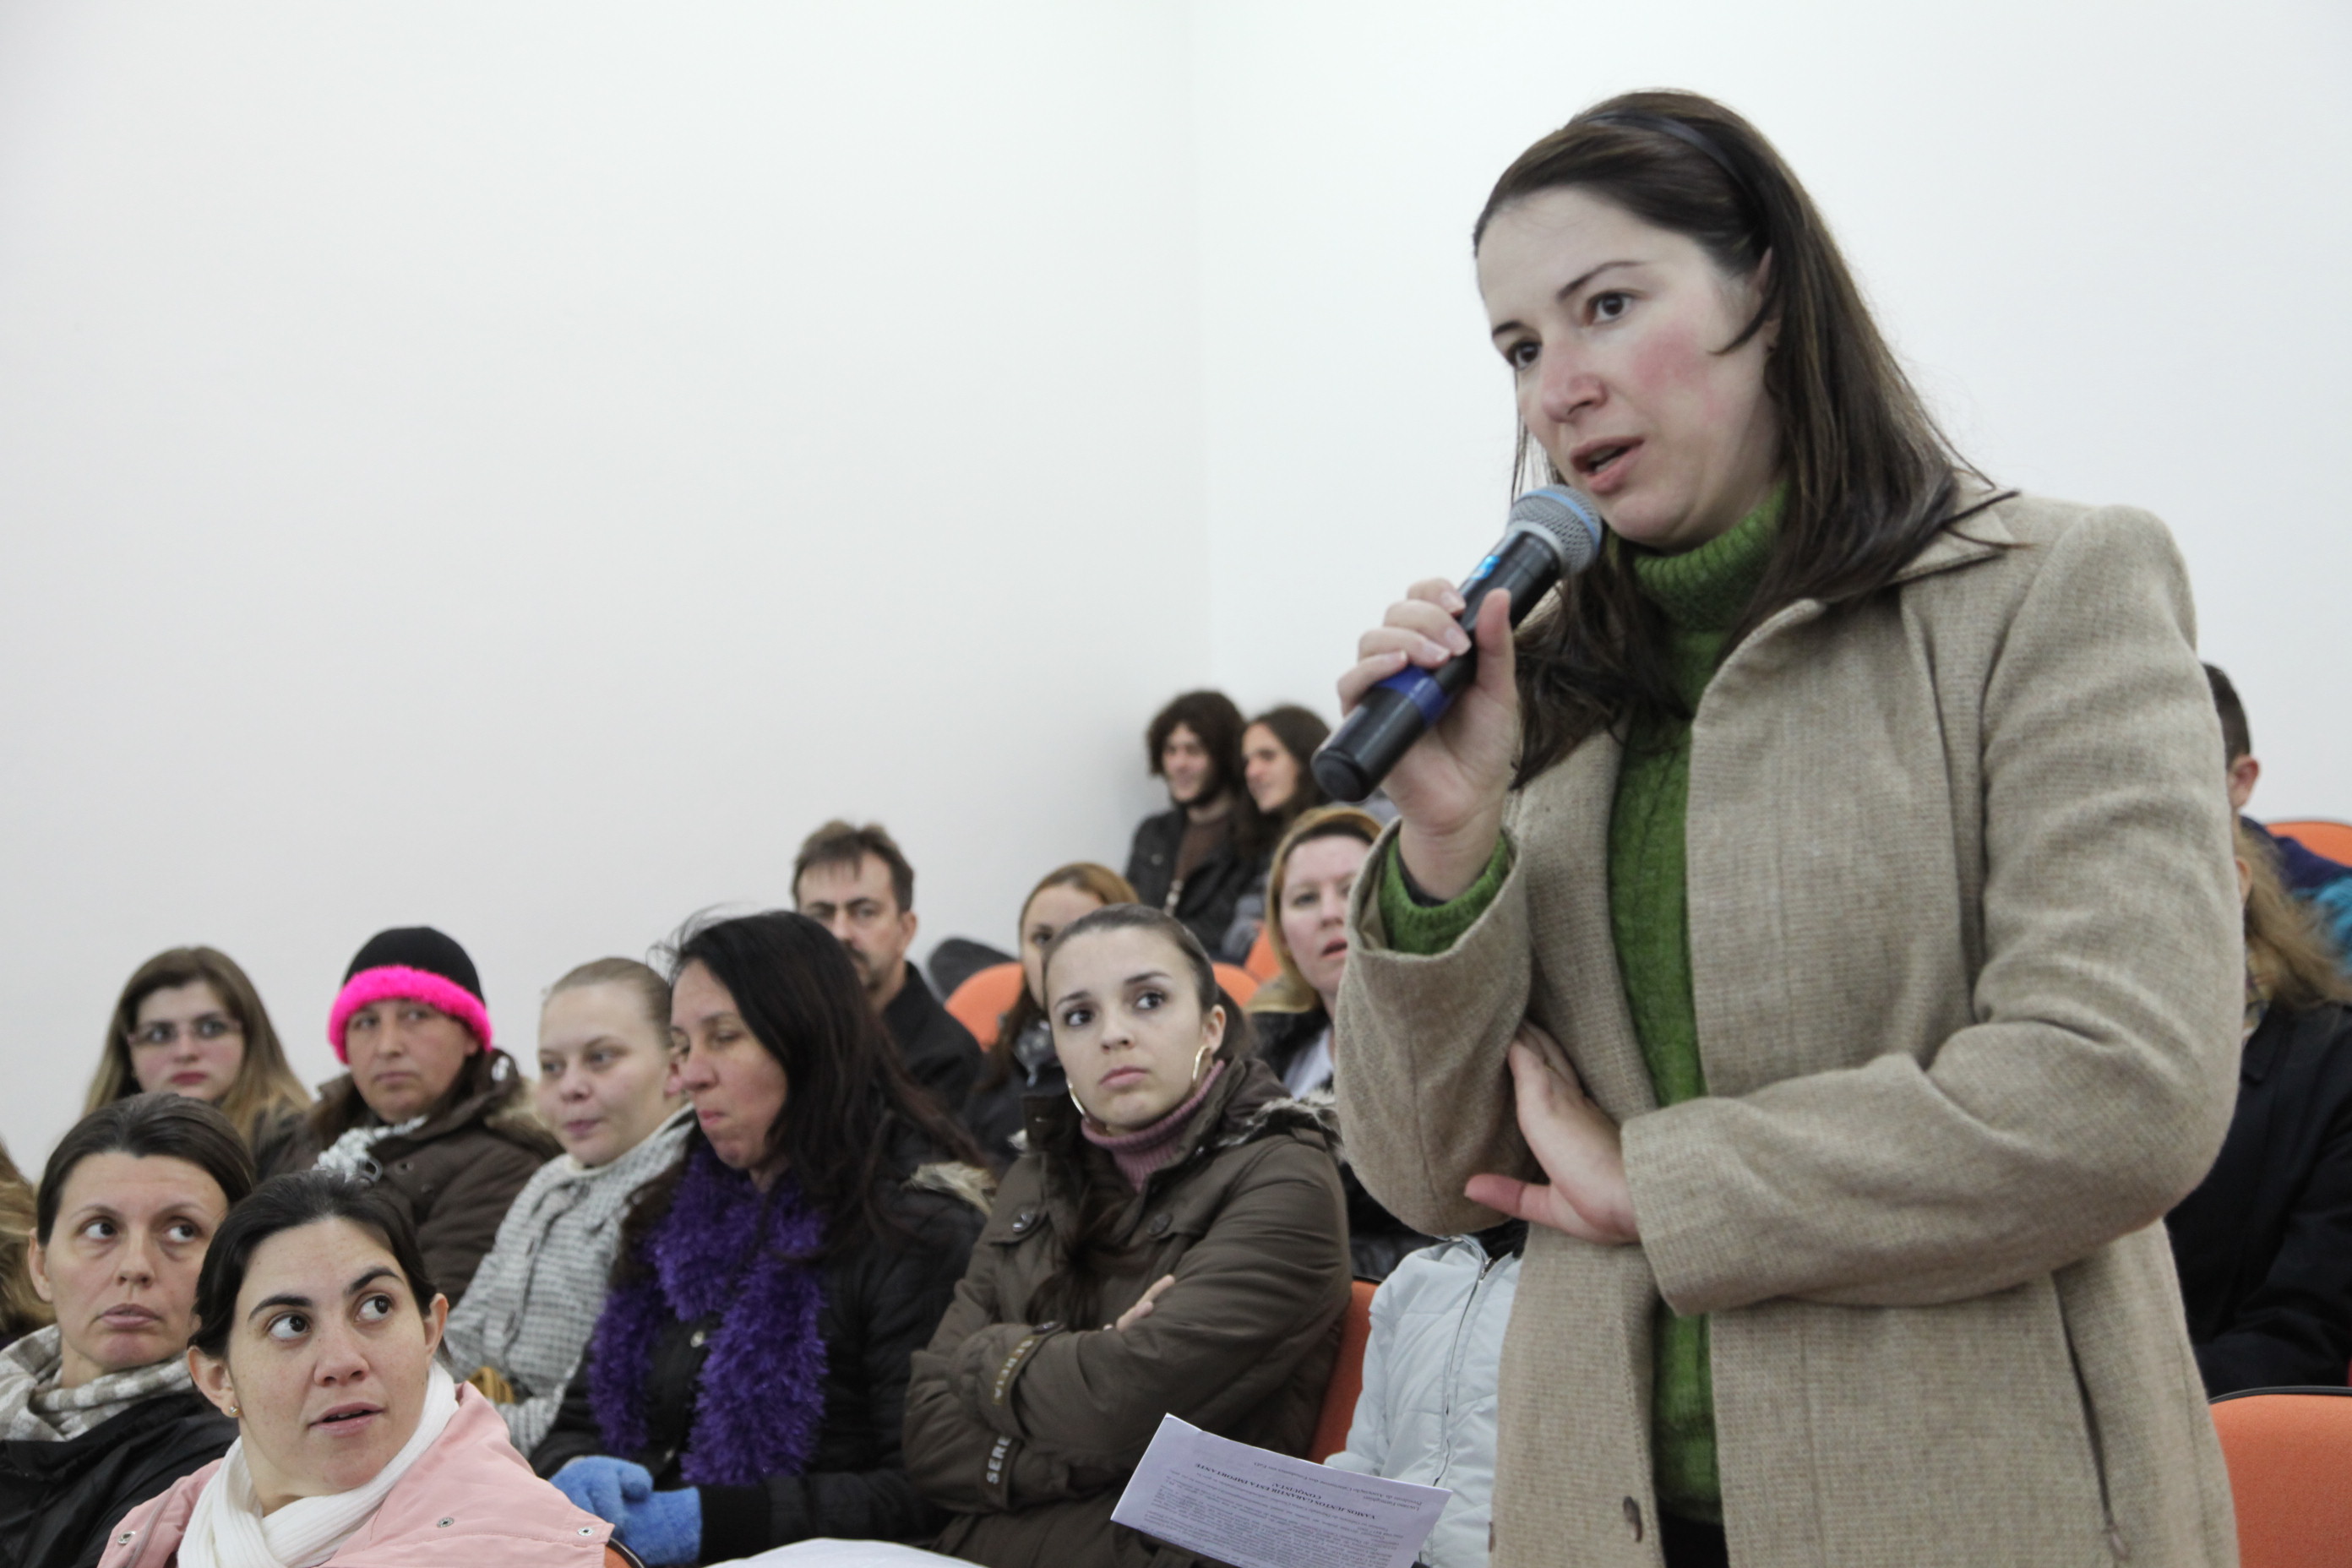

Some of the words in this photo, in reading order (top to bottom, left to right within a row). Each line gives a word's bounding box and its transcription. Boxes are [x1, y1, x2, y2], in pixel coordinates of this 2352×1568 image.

[1195, 1462, 1248, 1484] IMPORTANTE
[1271, 1488, 1314, 1503] GARANTIR
[1314, 1500, 1344, 1511] JUNTOS
[1346, 1509, 1375, 1519] VAMOS
